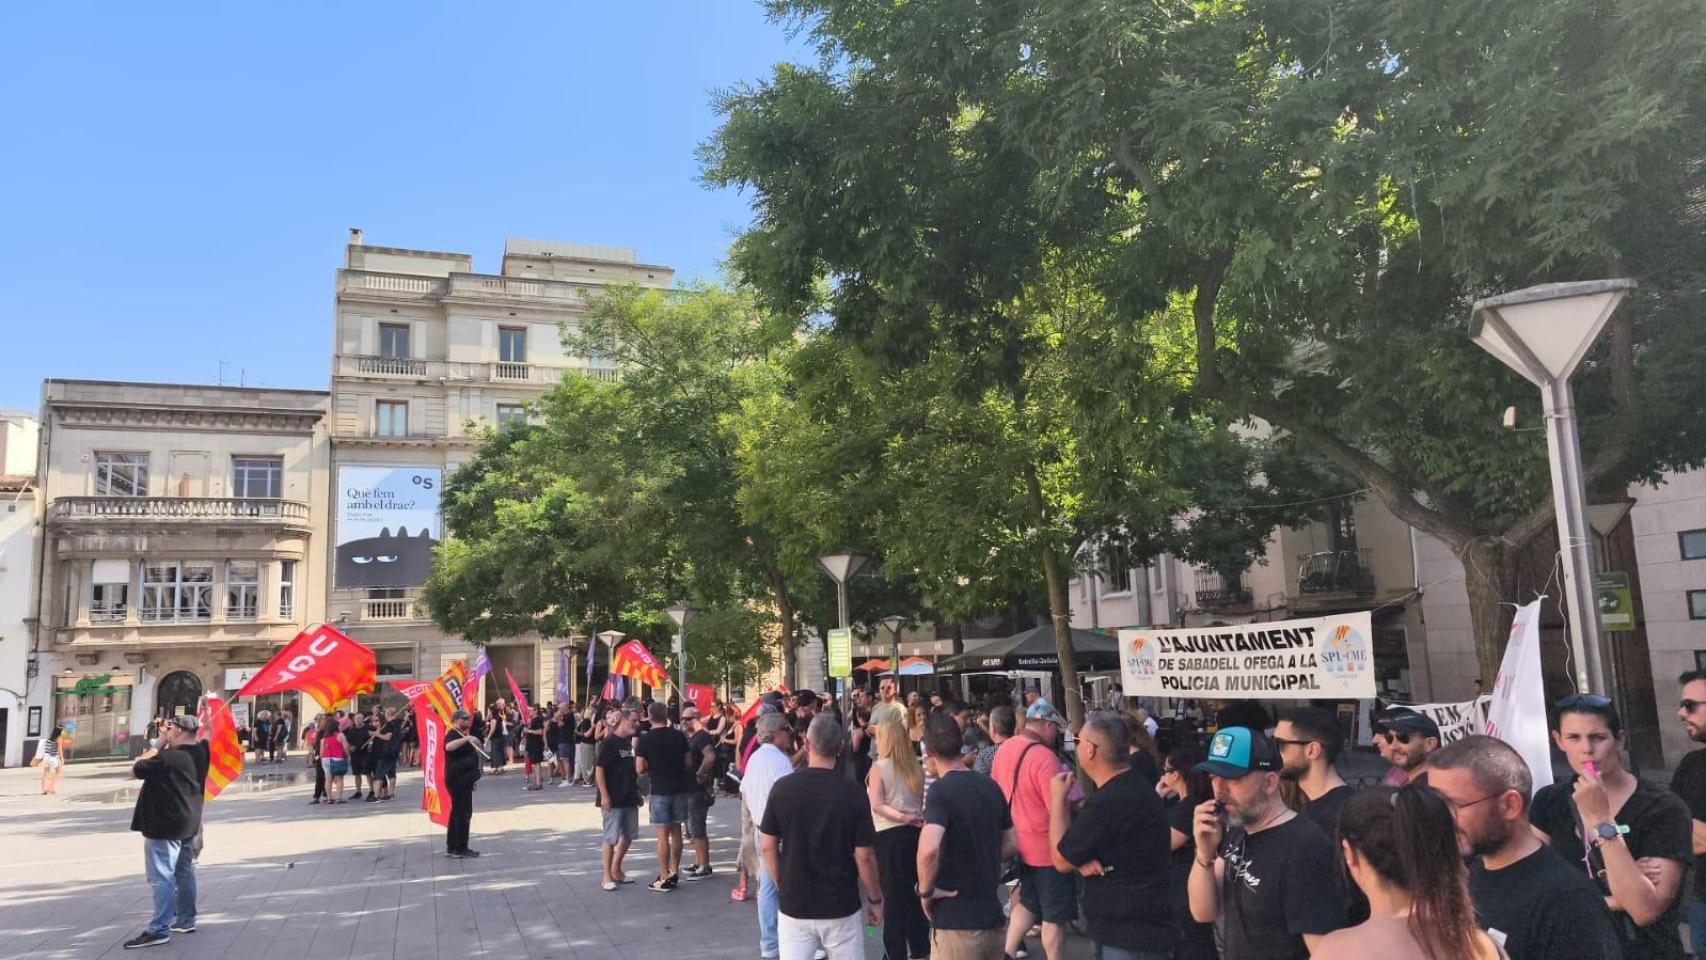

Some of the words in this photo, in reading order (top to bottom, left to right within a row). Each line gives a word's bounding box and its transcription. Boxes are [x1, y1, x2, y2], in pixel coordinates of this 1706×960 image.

[373, 488, 395, 499] fem
[347, 500, 372, 510] amb
[374, 500, 383, 510] el
[385, 500, 415, 510] drac?
[1157, 627, 1316, 653] L'AJUNTAMENT
[1158, 658, 1175, 671] DE
[1178, 657, 1240, 671] SABADELL
[1243, 655, 1285, 670] OFEGA
[1288, 654, 1296, 669] A
[1300, 653, 1317, 668] LA
[1161, 676, 1220, 691] POLICIA
[1226, 674, 1320, 691] MUNICIPAL
